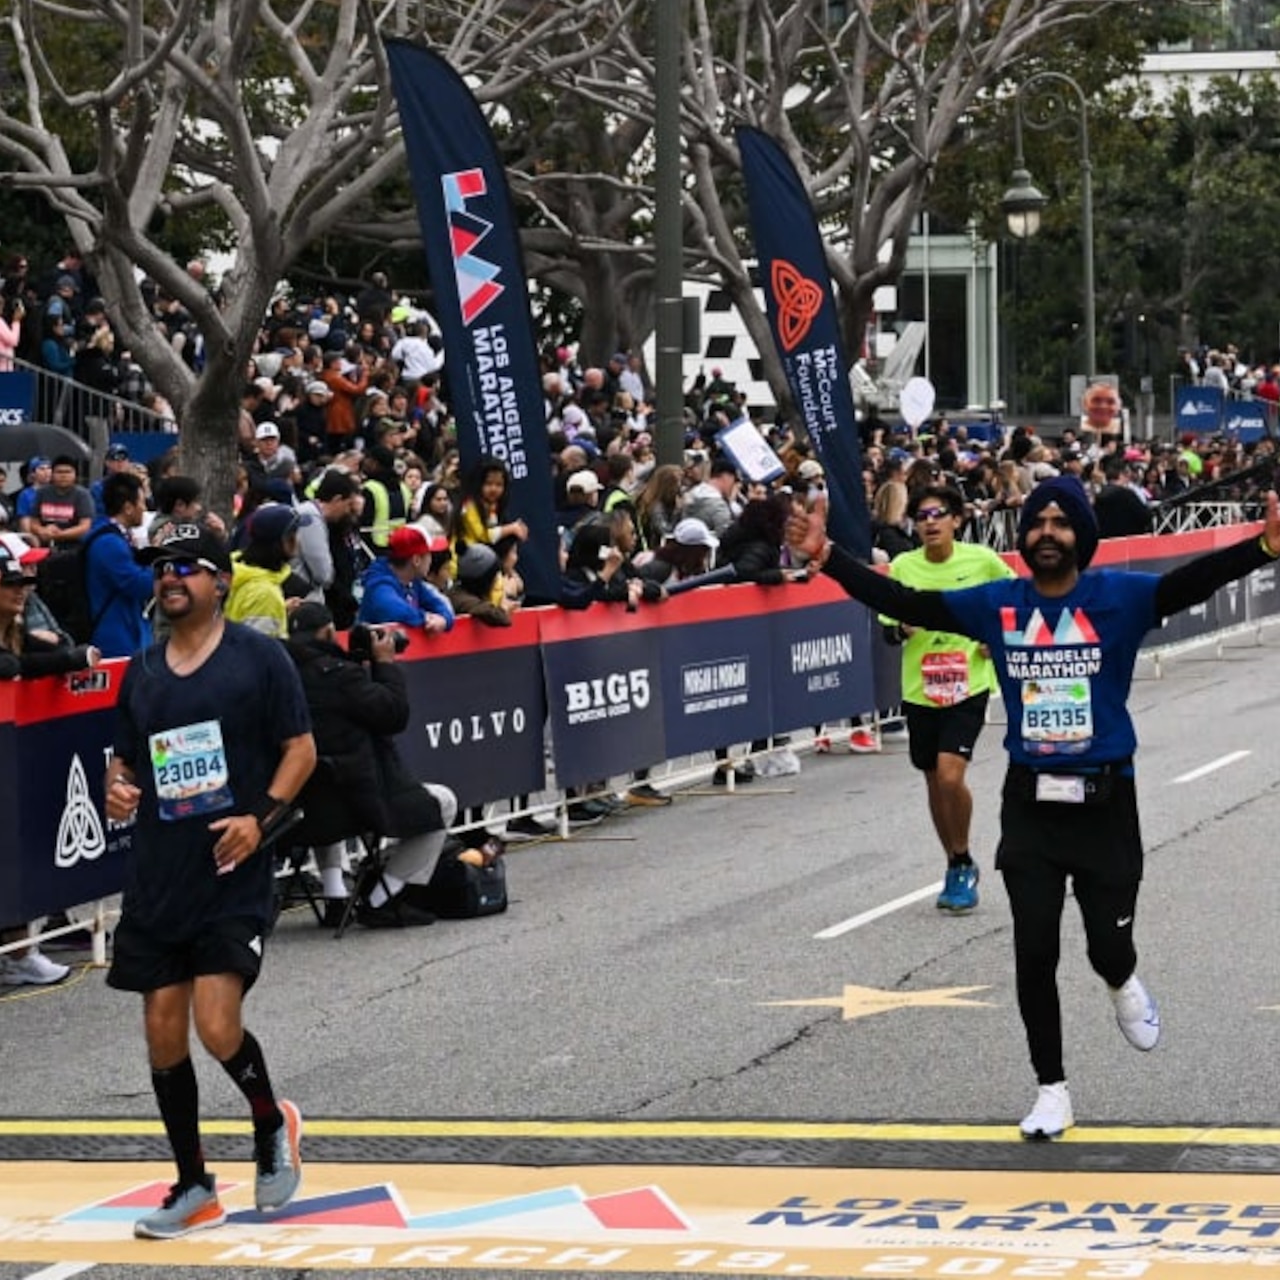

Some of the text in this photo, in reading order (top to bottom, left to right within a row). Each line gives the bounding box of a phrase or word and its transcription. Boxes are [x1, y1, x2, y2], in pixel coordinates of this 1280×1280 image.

[825, 344, 838, 380] The
[472, 328, 512, 470] MARATHO
[489, 324, 529, 480] LOS ANGELES
[812, 349, 839, 432] McCourt
[791, 633, 852, 674] HAWAIIAN
[1006, 647, 1102, 664] LOS ANGELES
[1007, 660, 1101, 679] MARATHON
[426, 707, 526, 748] VOLVO
[158, 755, 223, 785] 23084
[777, 1196, 967, 1212] LOS
[211, 1243, 1154, 1278] MARCH 19, 2023
